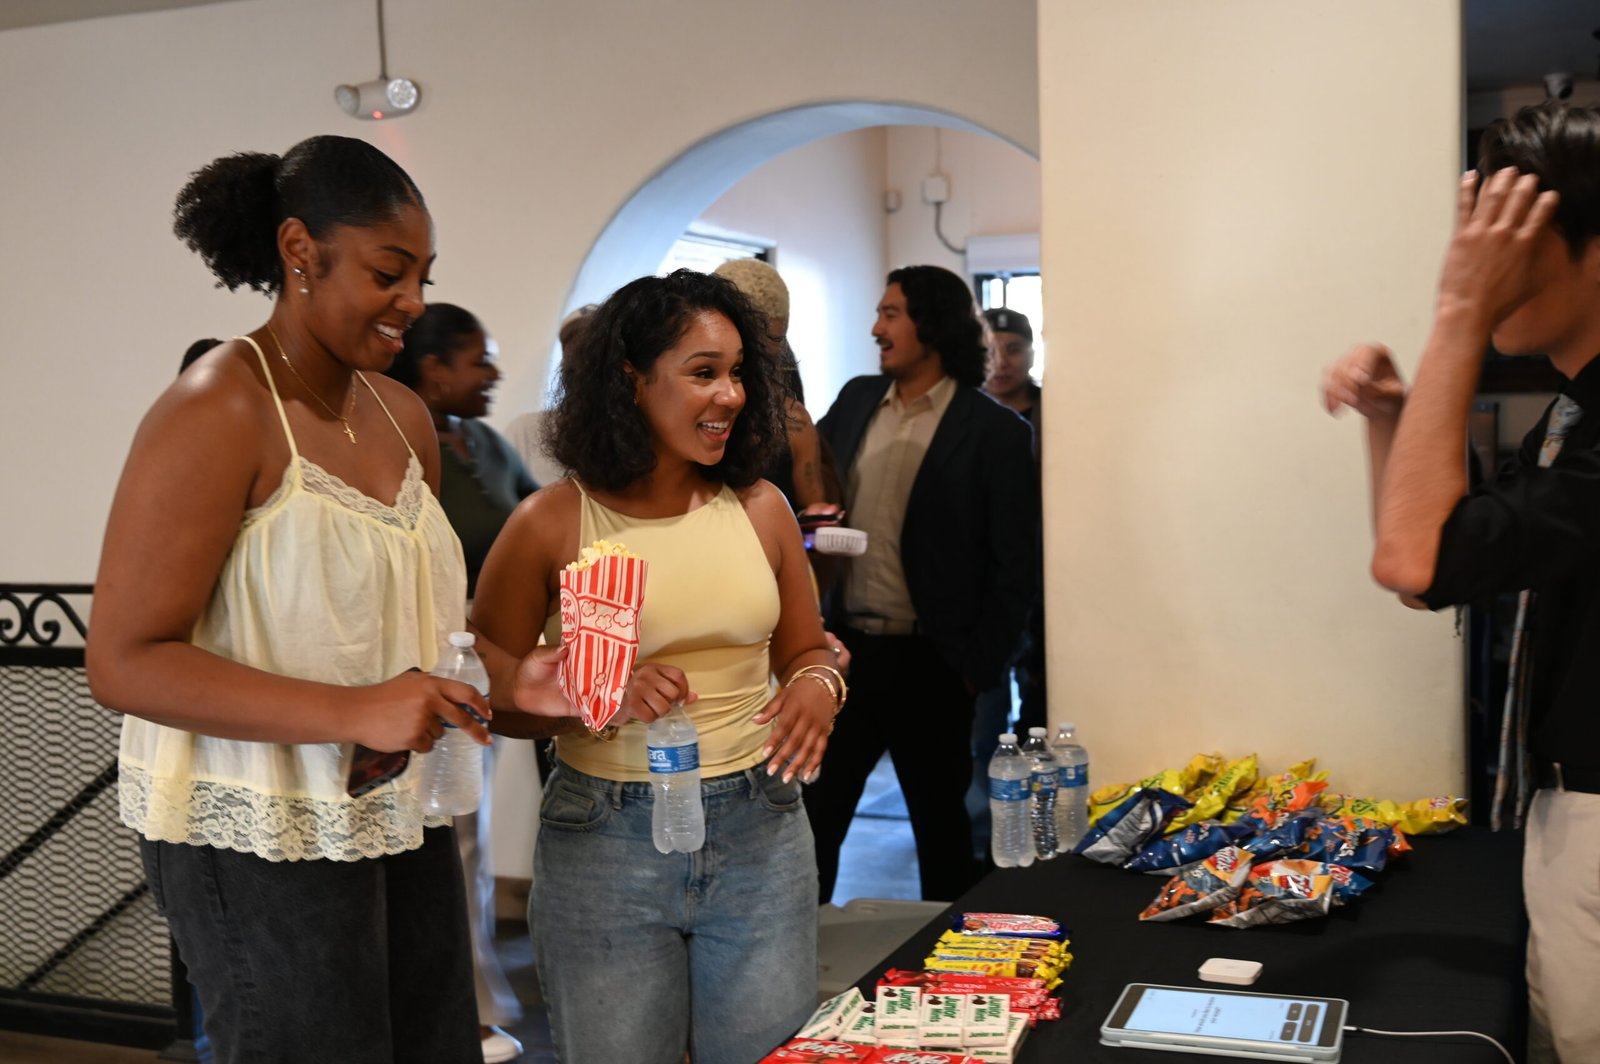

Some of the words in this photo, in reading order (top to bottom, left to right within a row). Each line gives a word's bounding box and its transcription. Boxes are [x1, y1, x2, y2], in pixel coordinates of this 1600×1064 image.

[885, 1000, 898, 1014] Mints
[900, 988, 916, 1011] Junior
[944, 996, 960, 1018] Junior
[988, 996, 1004, 1018] Junior
[930, 1008, 943, 1022] Mints
[975, 1007, 987, 1022] Mints
